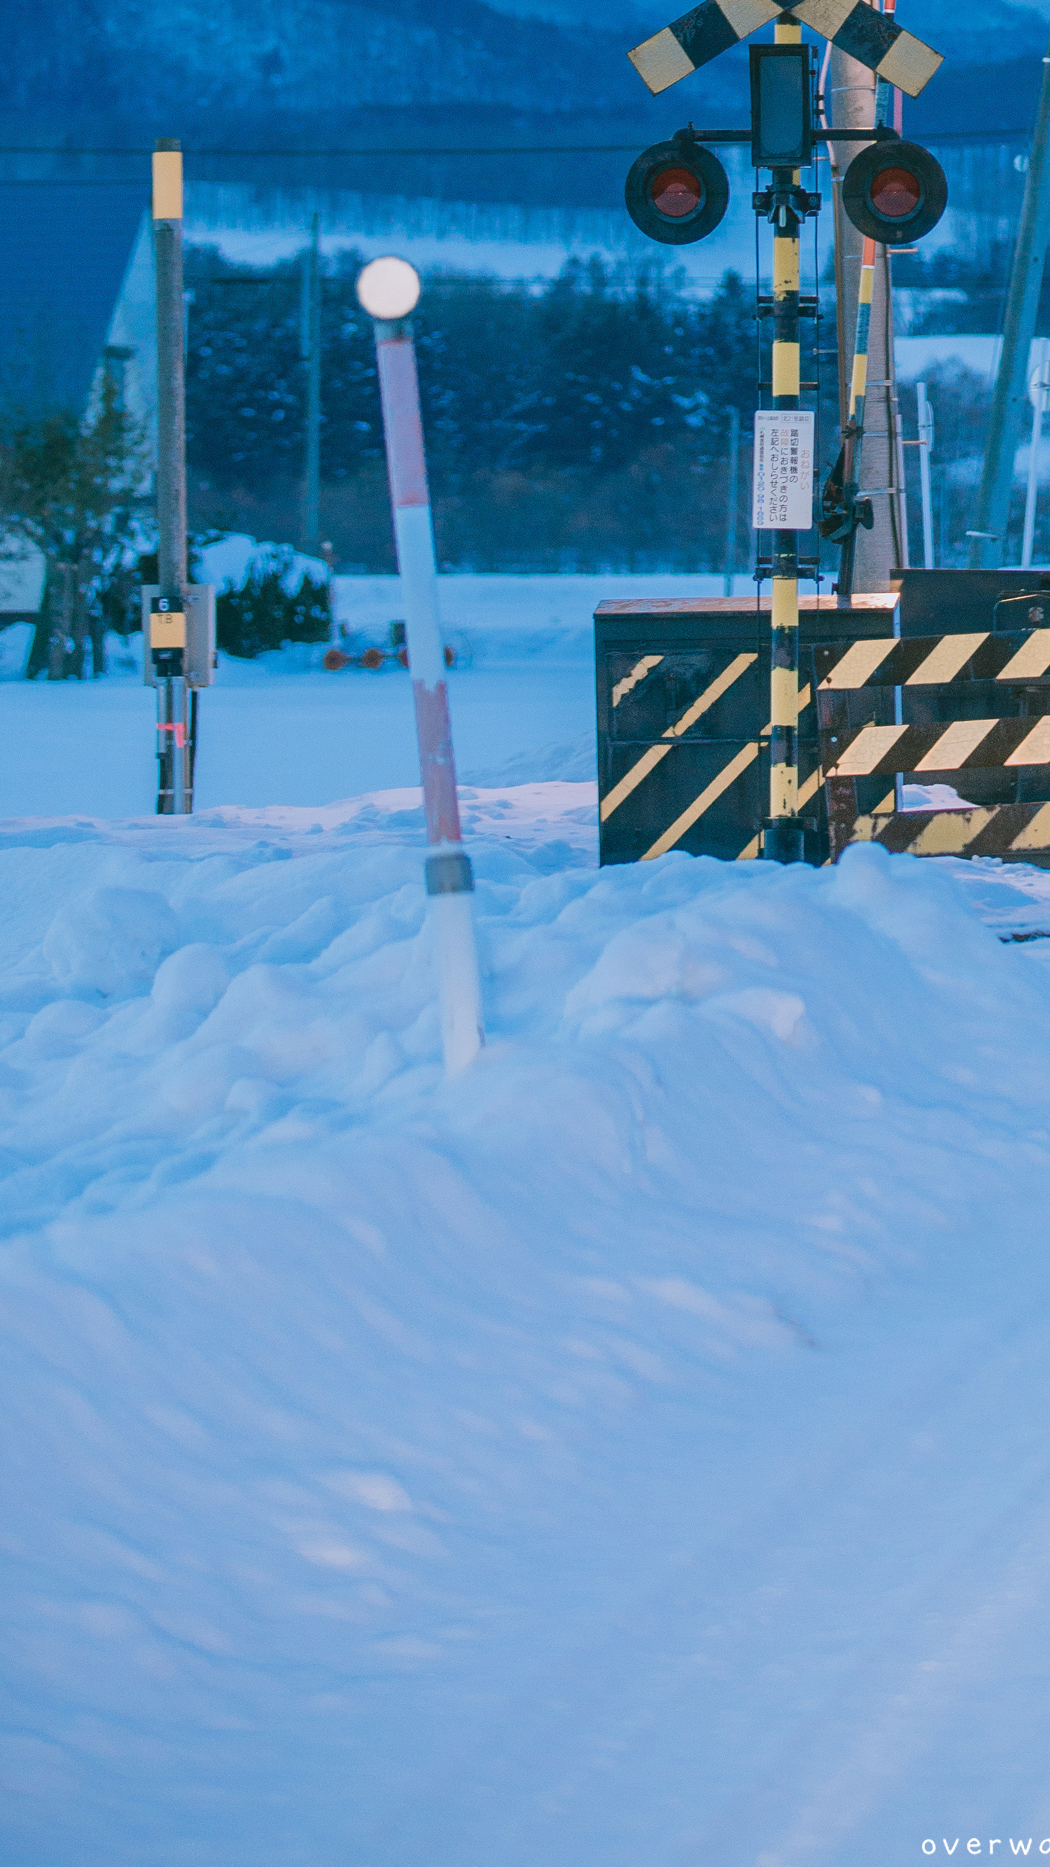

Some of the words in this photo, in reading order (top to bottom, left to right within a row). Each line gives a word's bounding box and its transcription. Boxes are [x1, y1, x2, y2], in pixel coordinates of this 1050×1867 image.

[769, 428, 780, 522] 左記へおしらせください
[800, 449, 810, 490] おねがい
[158, 598, 170, 612] 6
